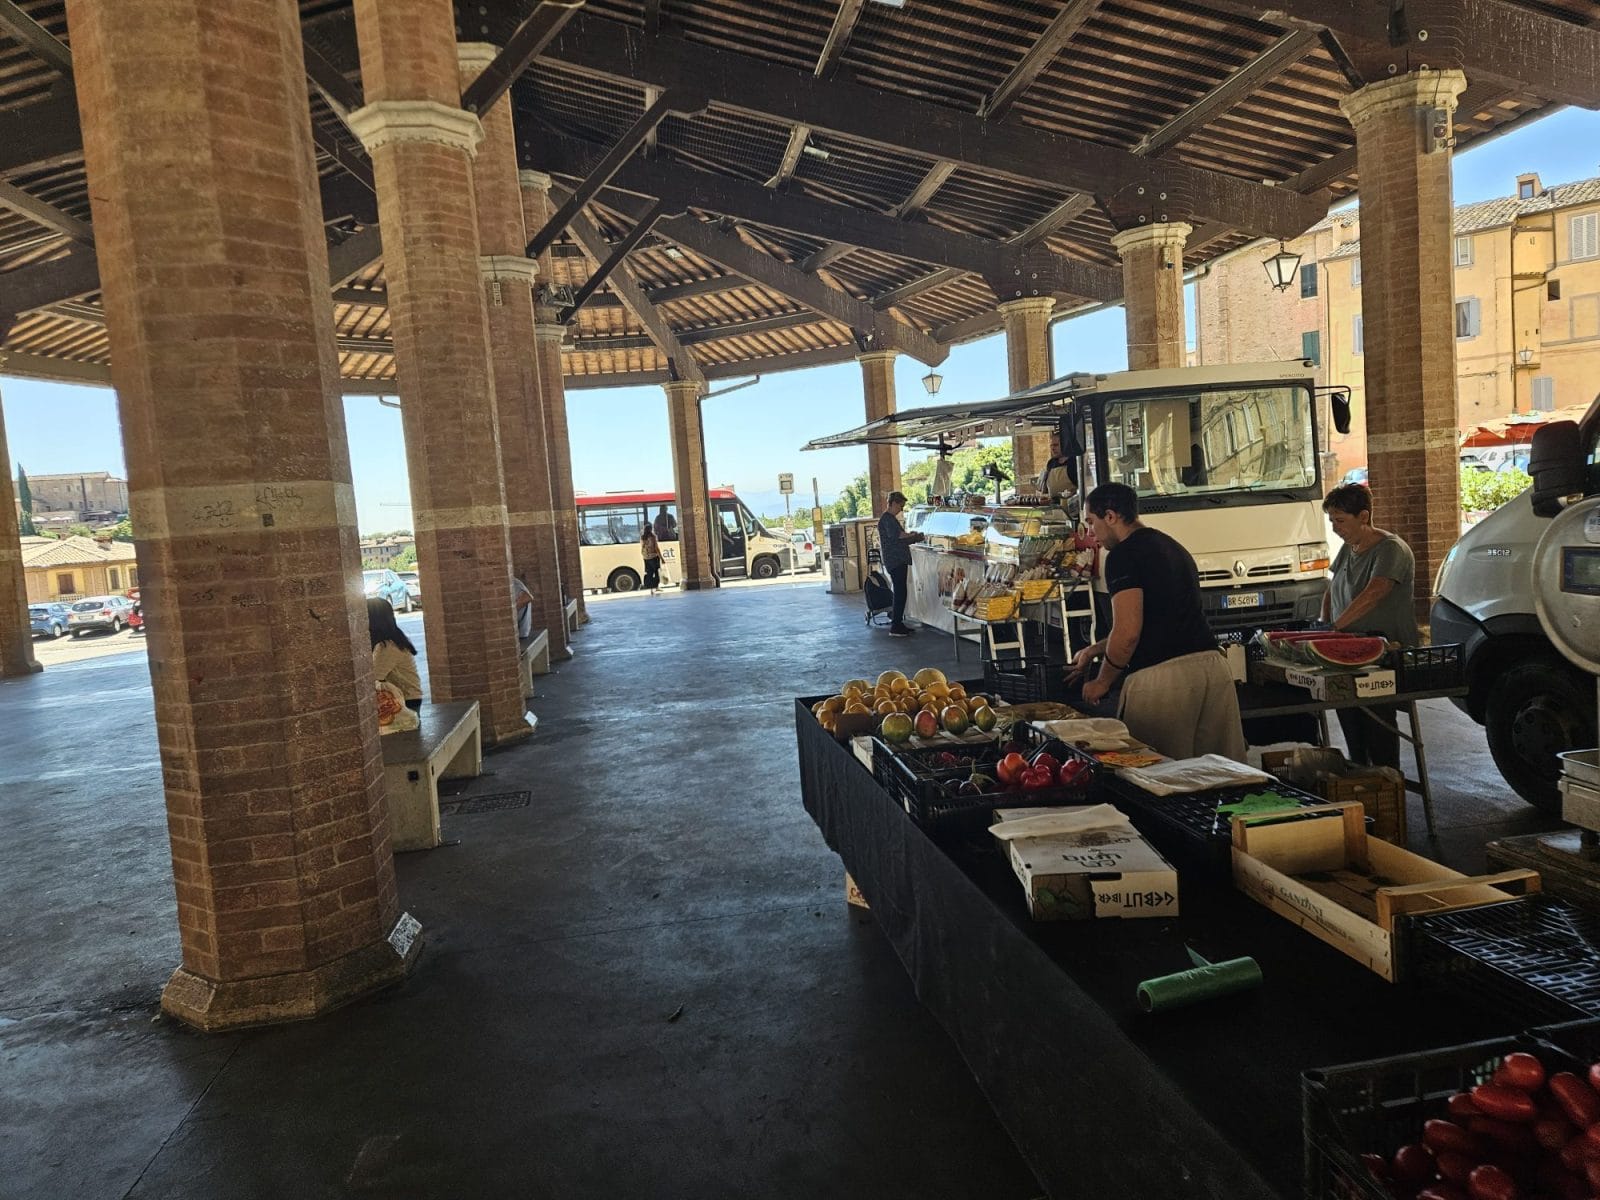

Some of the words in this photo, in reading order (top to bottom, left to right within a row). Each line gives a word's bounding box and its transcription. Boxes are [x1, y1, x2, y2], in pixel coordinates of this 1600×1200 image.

[1370, 680, 1394, 690] GEBUT
[1098, 892, 1122, 904] IBER
[1124, 890, 1175, 908] GEBUT
[1279, 887, 1323, 917] GANDINI
